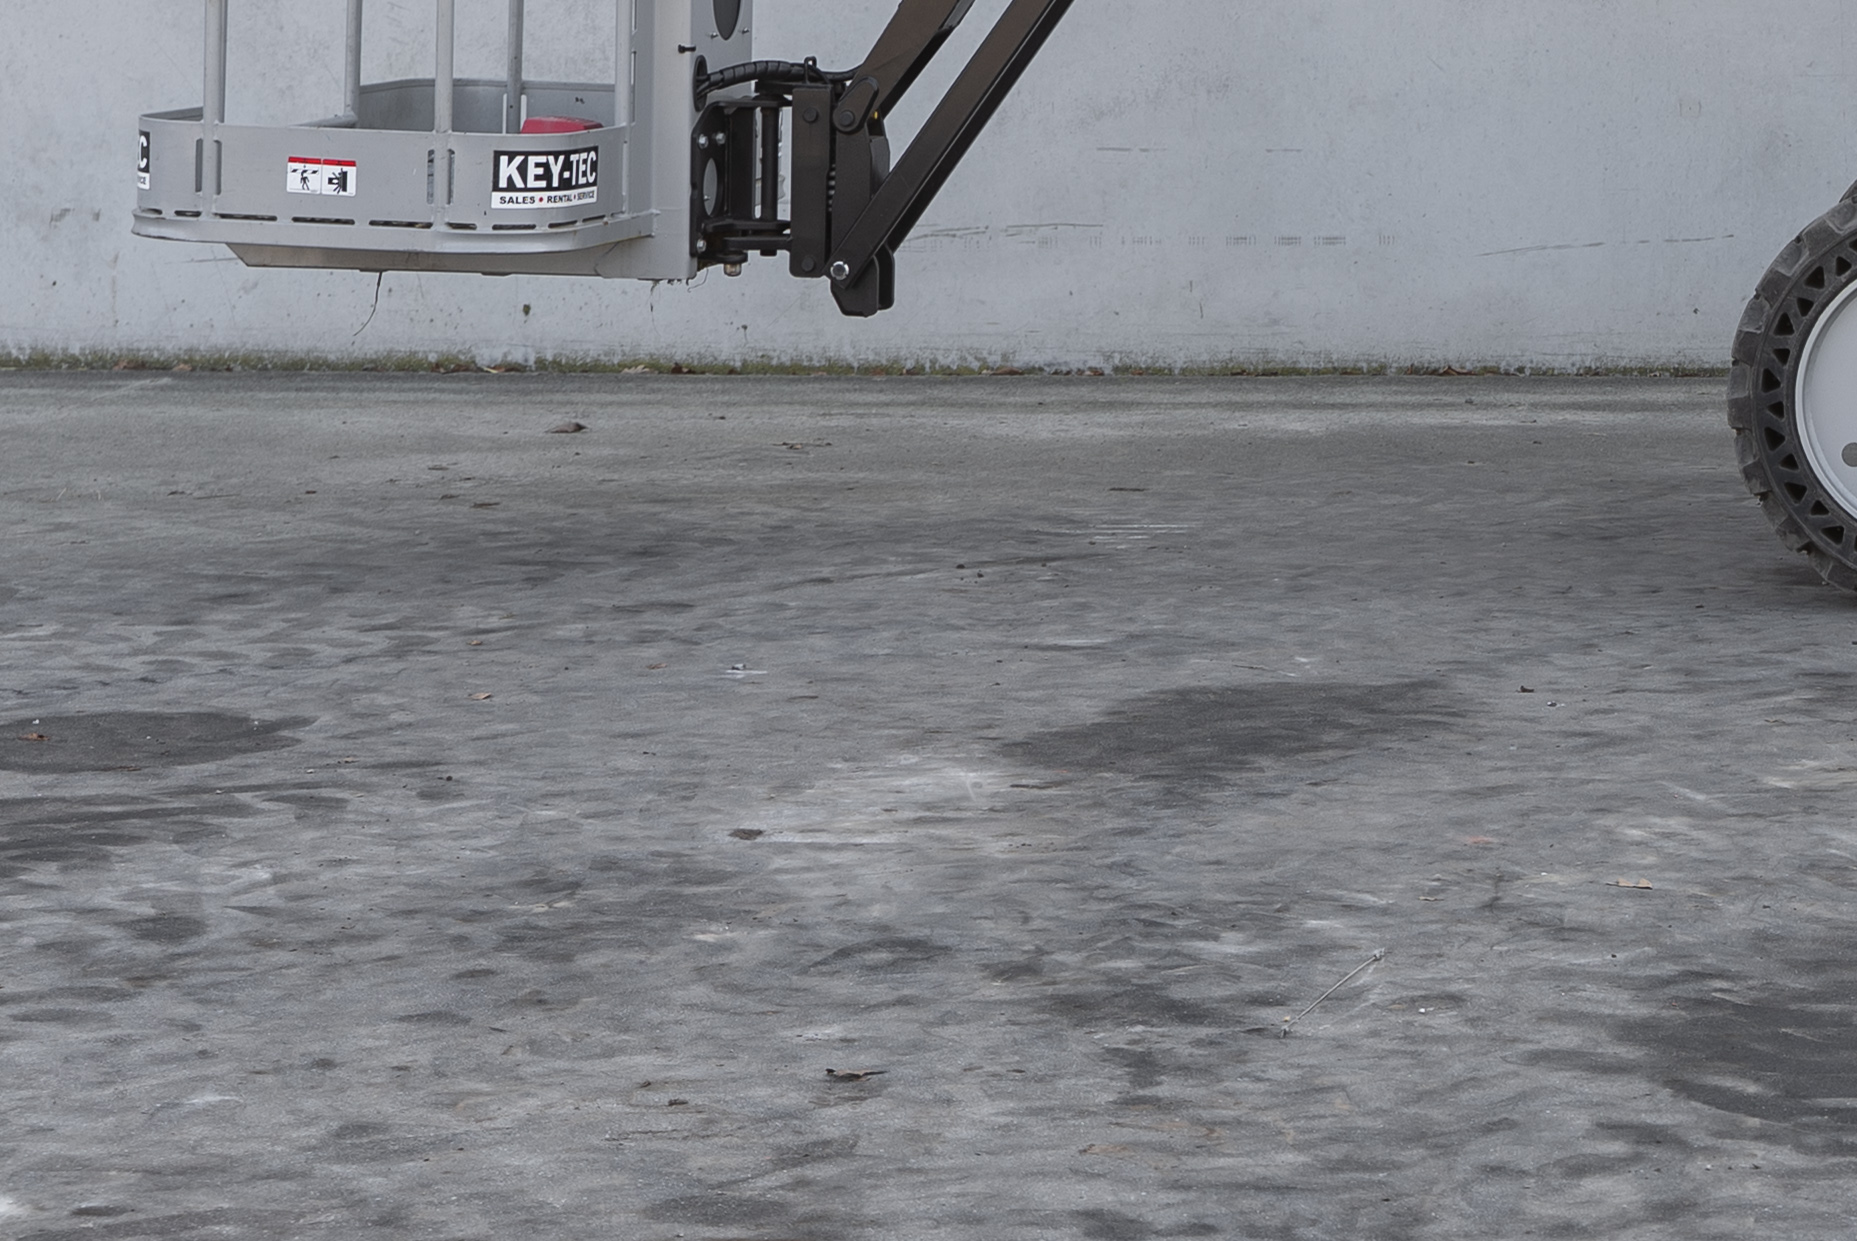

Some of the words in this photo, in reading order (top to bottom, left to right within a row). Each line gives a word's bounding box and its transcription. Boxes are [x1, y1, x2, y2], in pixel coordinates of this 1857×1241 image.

[498, 150, 597, 189] KEY-TEC
[499, 195, 536, 205] SALES
[546, 193, 573, 204] RENTAL
